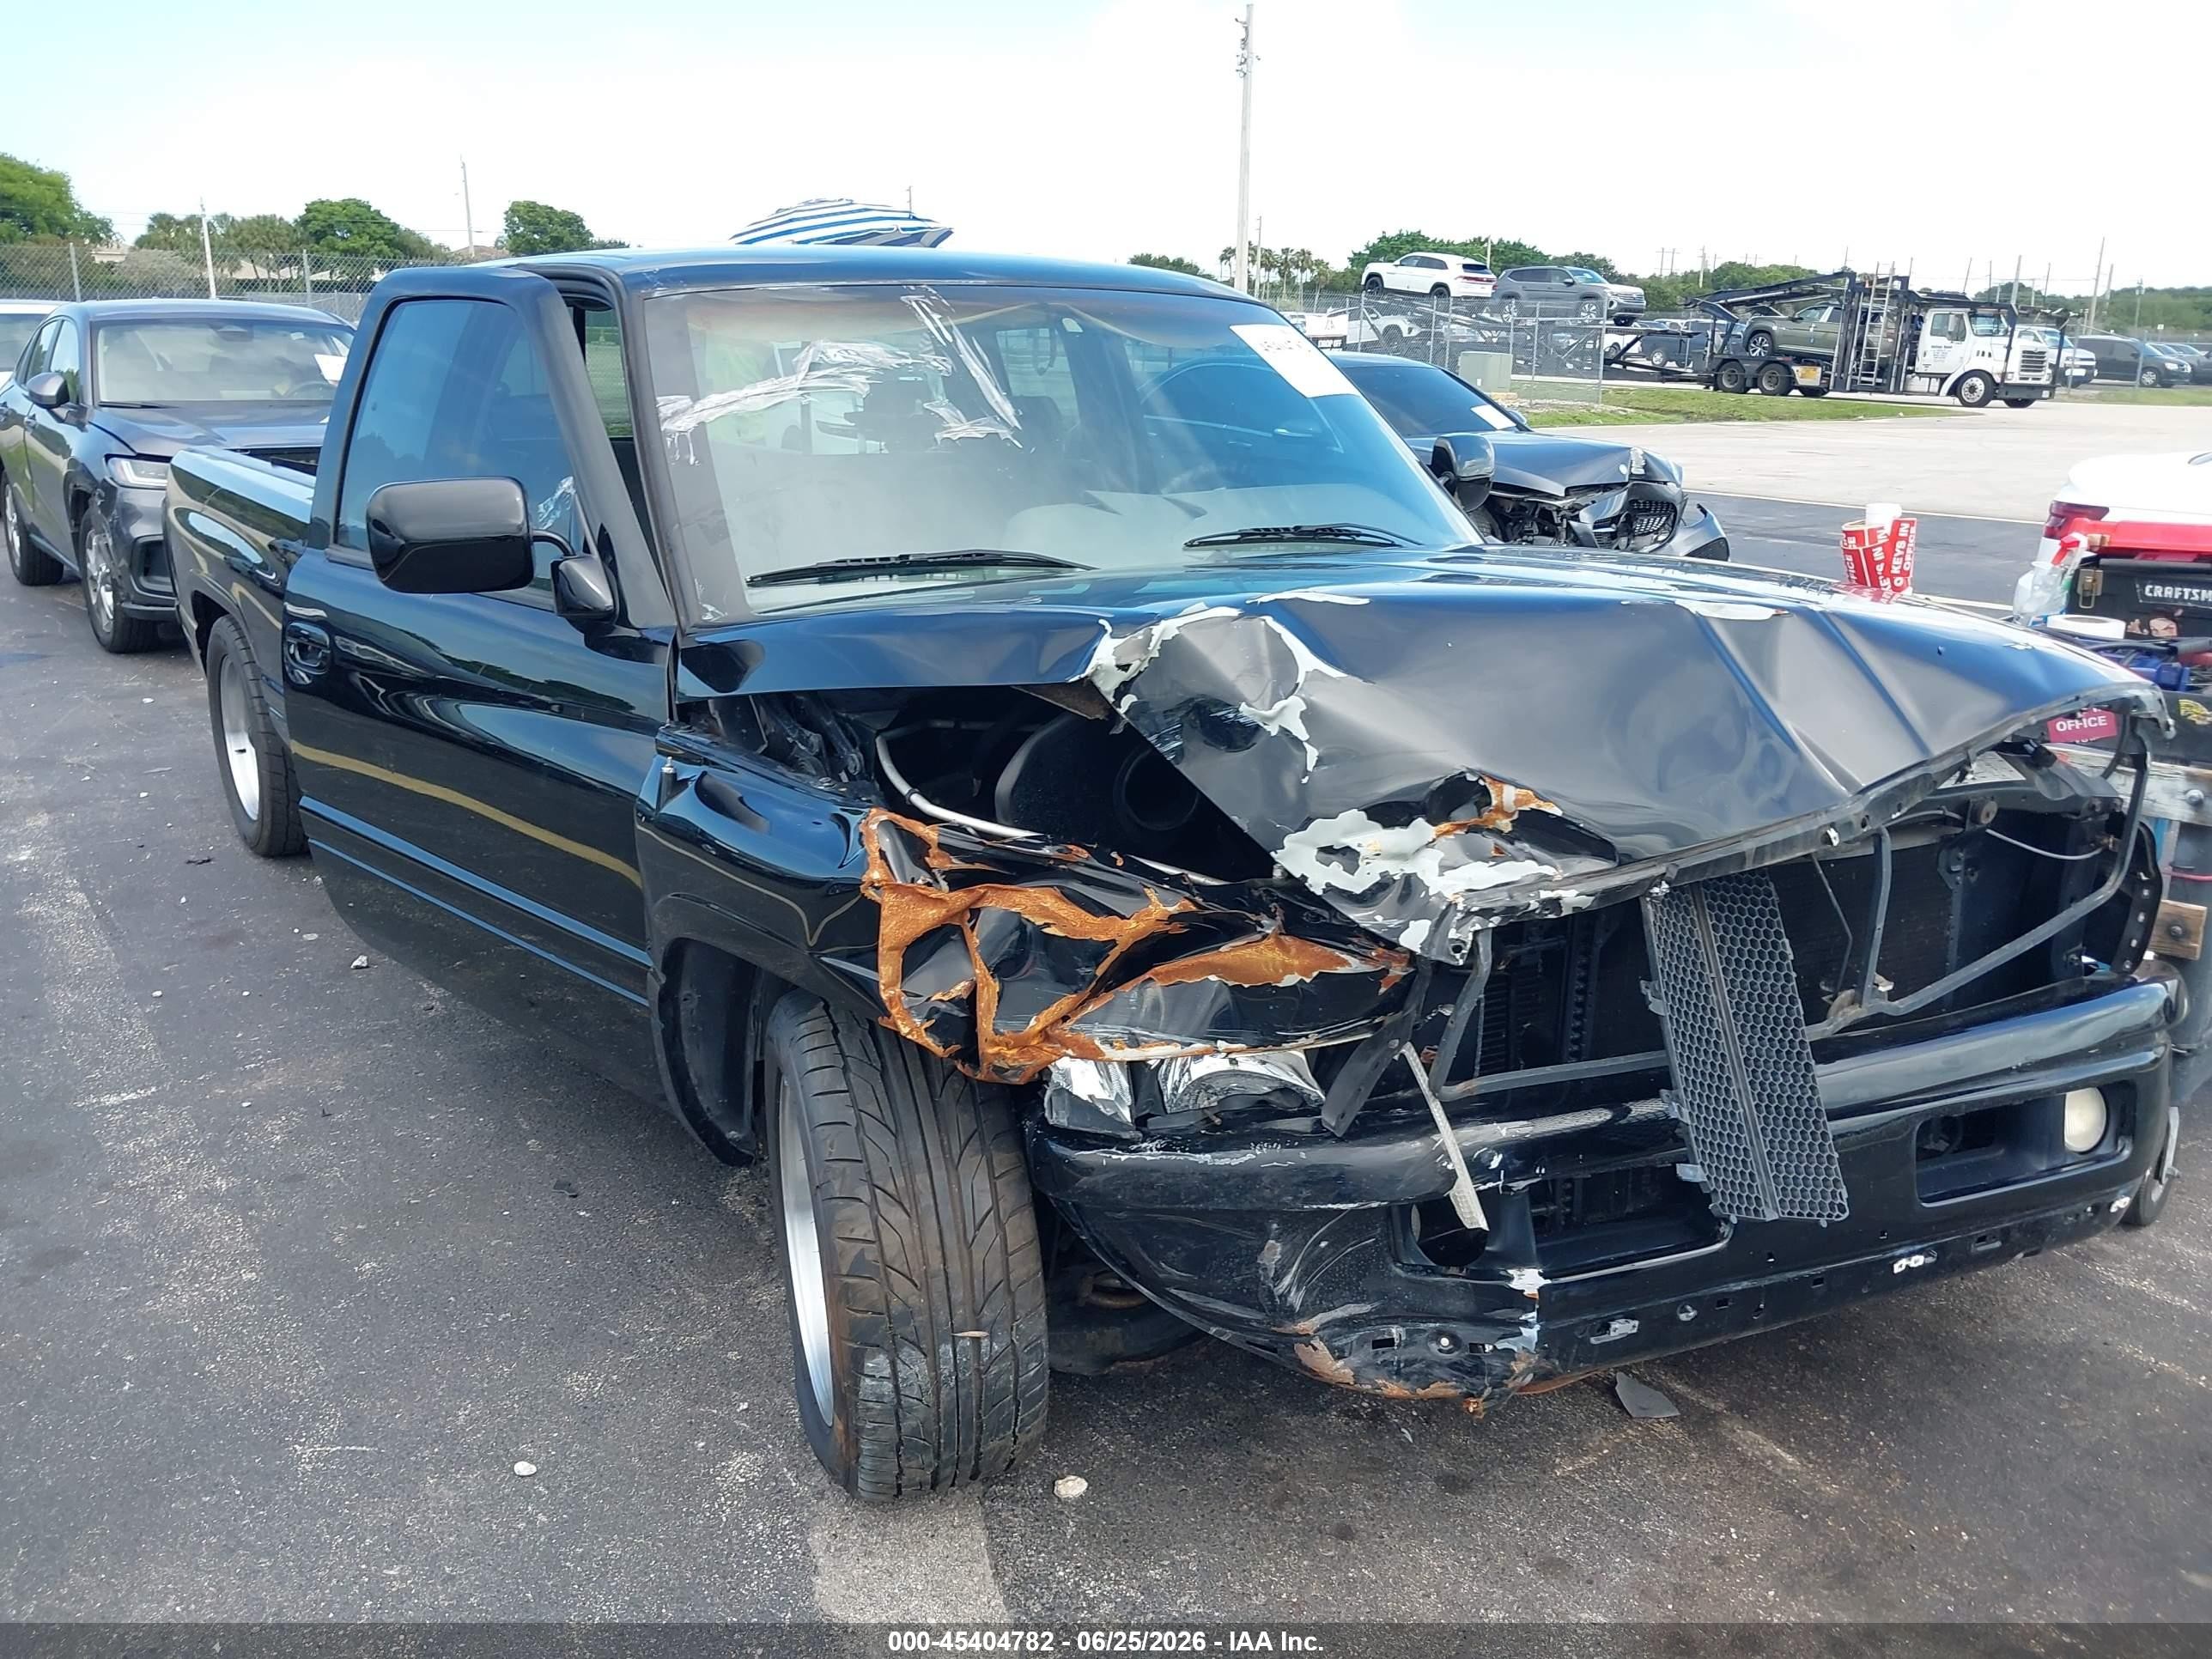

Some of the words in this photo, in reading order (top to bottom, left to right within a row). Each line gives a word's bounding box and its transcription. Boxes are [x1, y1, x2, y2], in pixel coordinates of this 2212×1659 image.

[1872, 546, 1885, 561] IN
[1891, 540, 1906, 574] KEYS
[1899, 522, 1911, 537] IN
[1903, 526, 1916, 571] OFFICE
[2056, 715, 2108, 732] OFFICE
